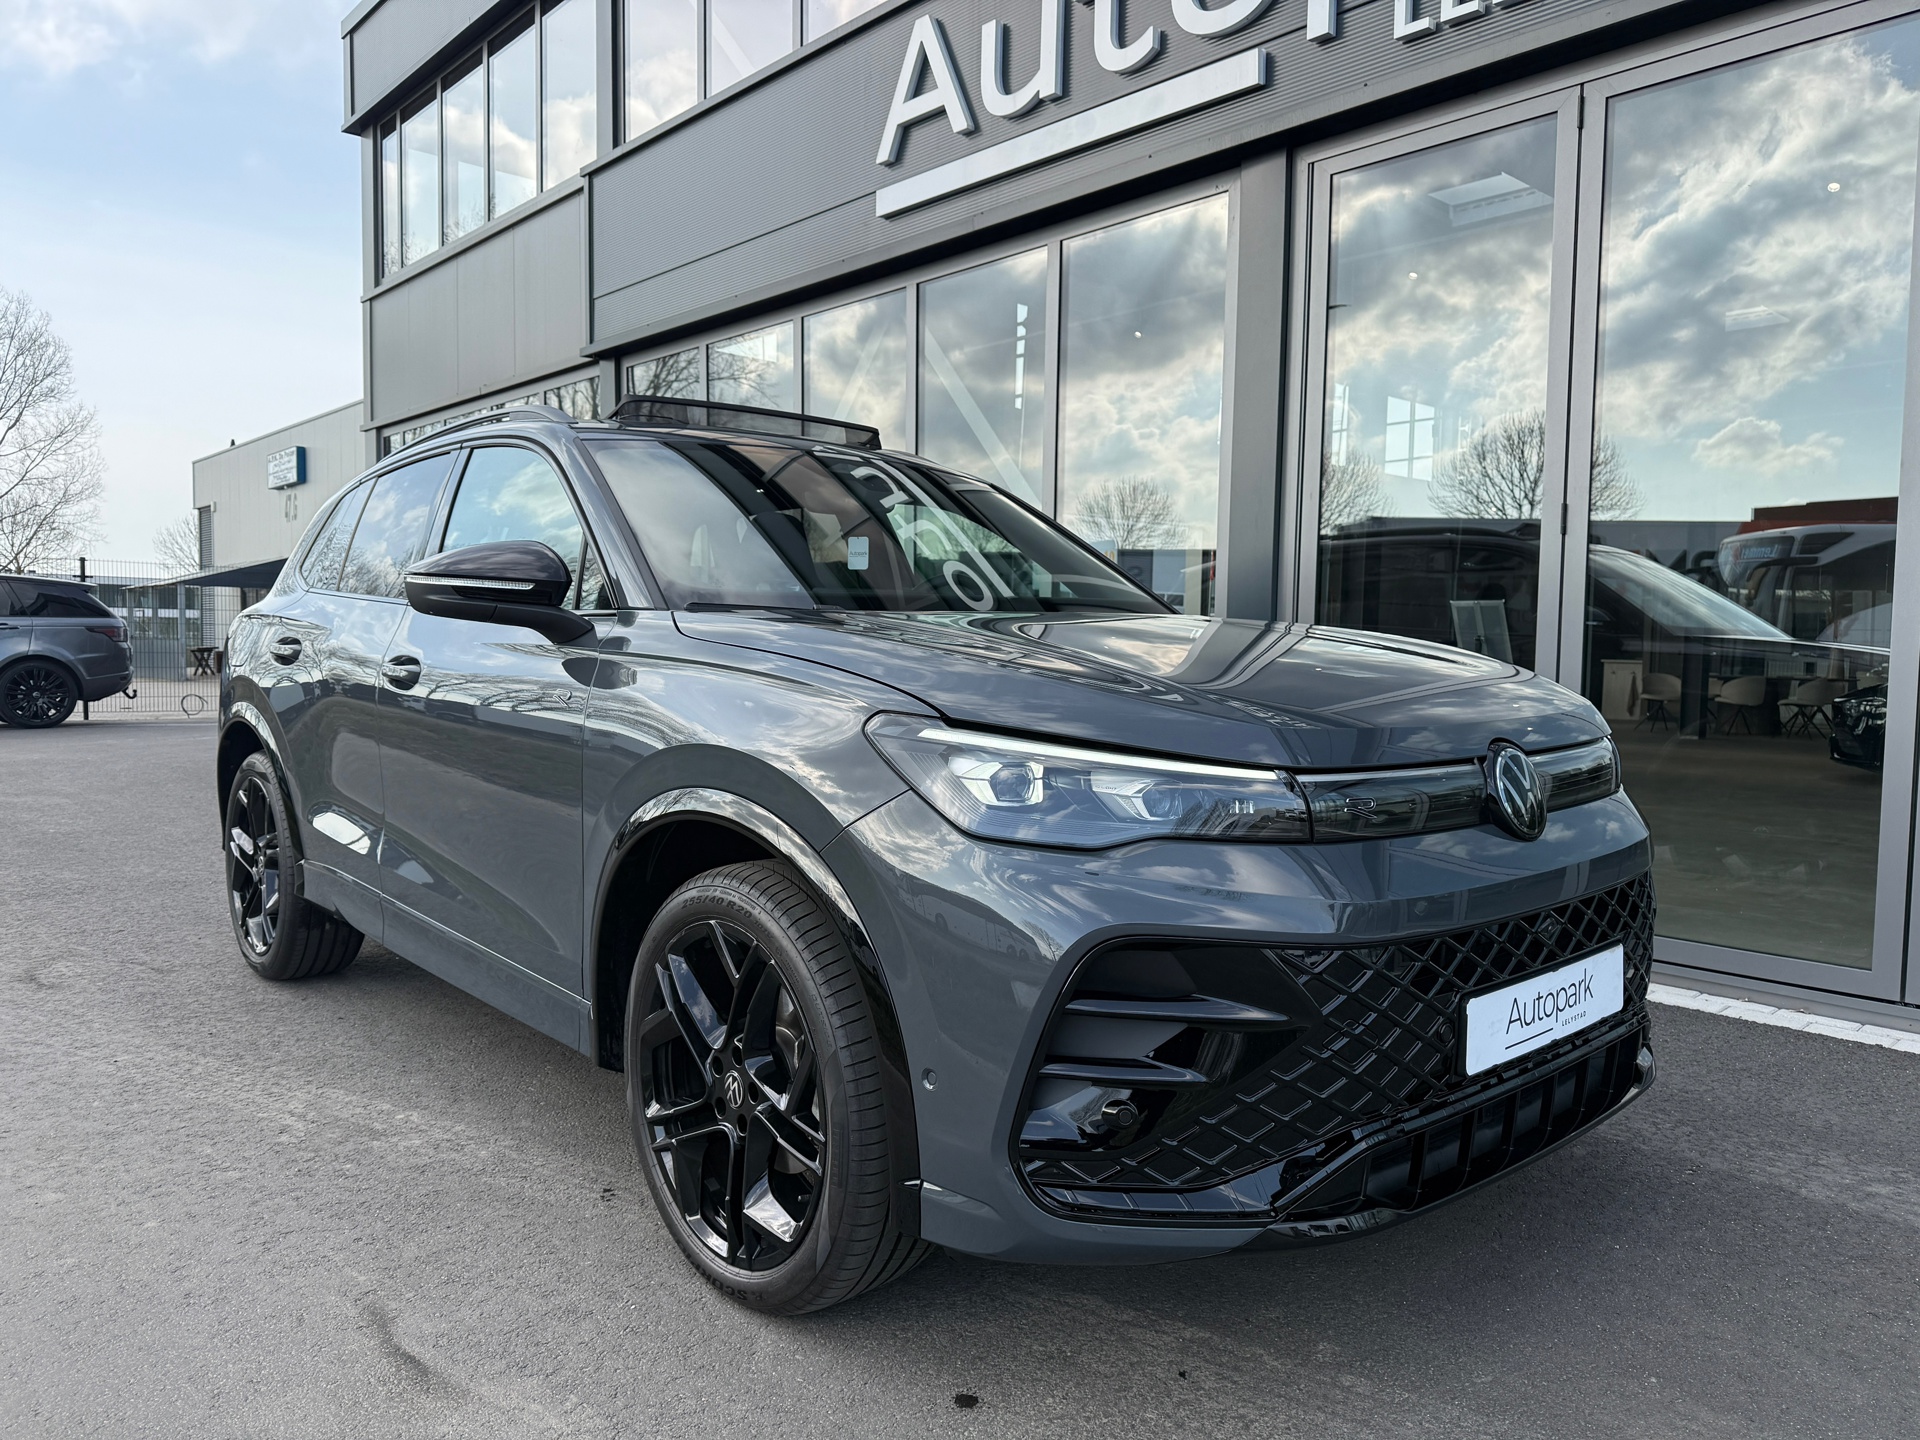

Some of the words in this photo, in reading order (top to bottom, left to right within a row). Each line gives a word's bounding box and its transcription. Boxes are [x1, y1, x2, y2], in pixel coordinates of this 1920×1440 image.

[681, 895, 724, 910] 255/40
[1505, 967, 1594, 1035] Autopark
[1561, 1010, 1587, 1027] LELYSTAD
